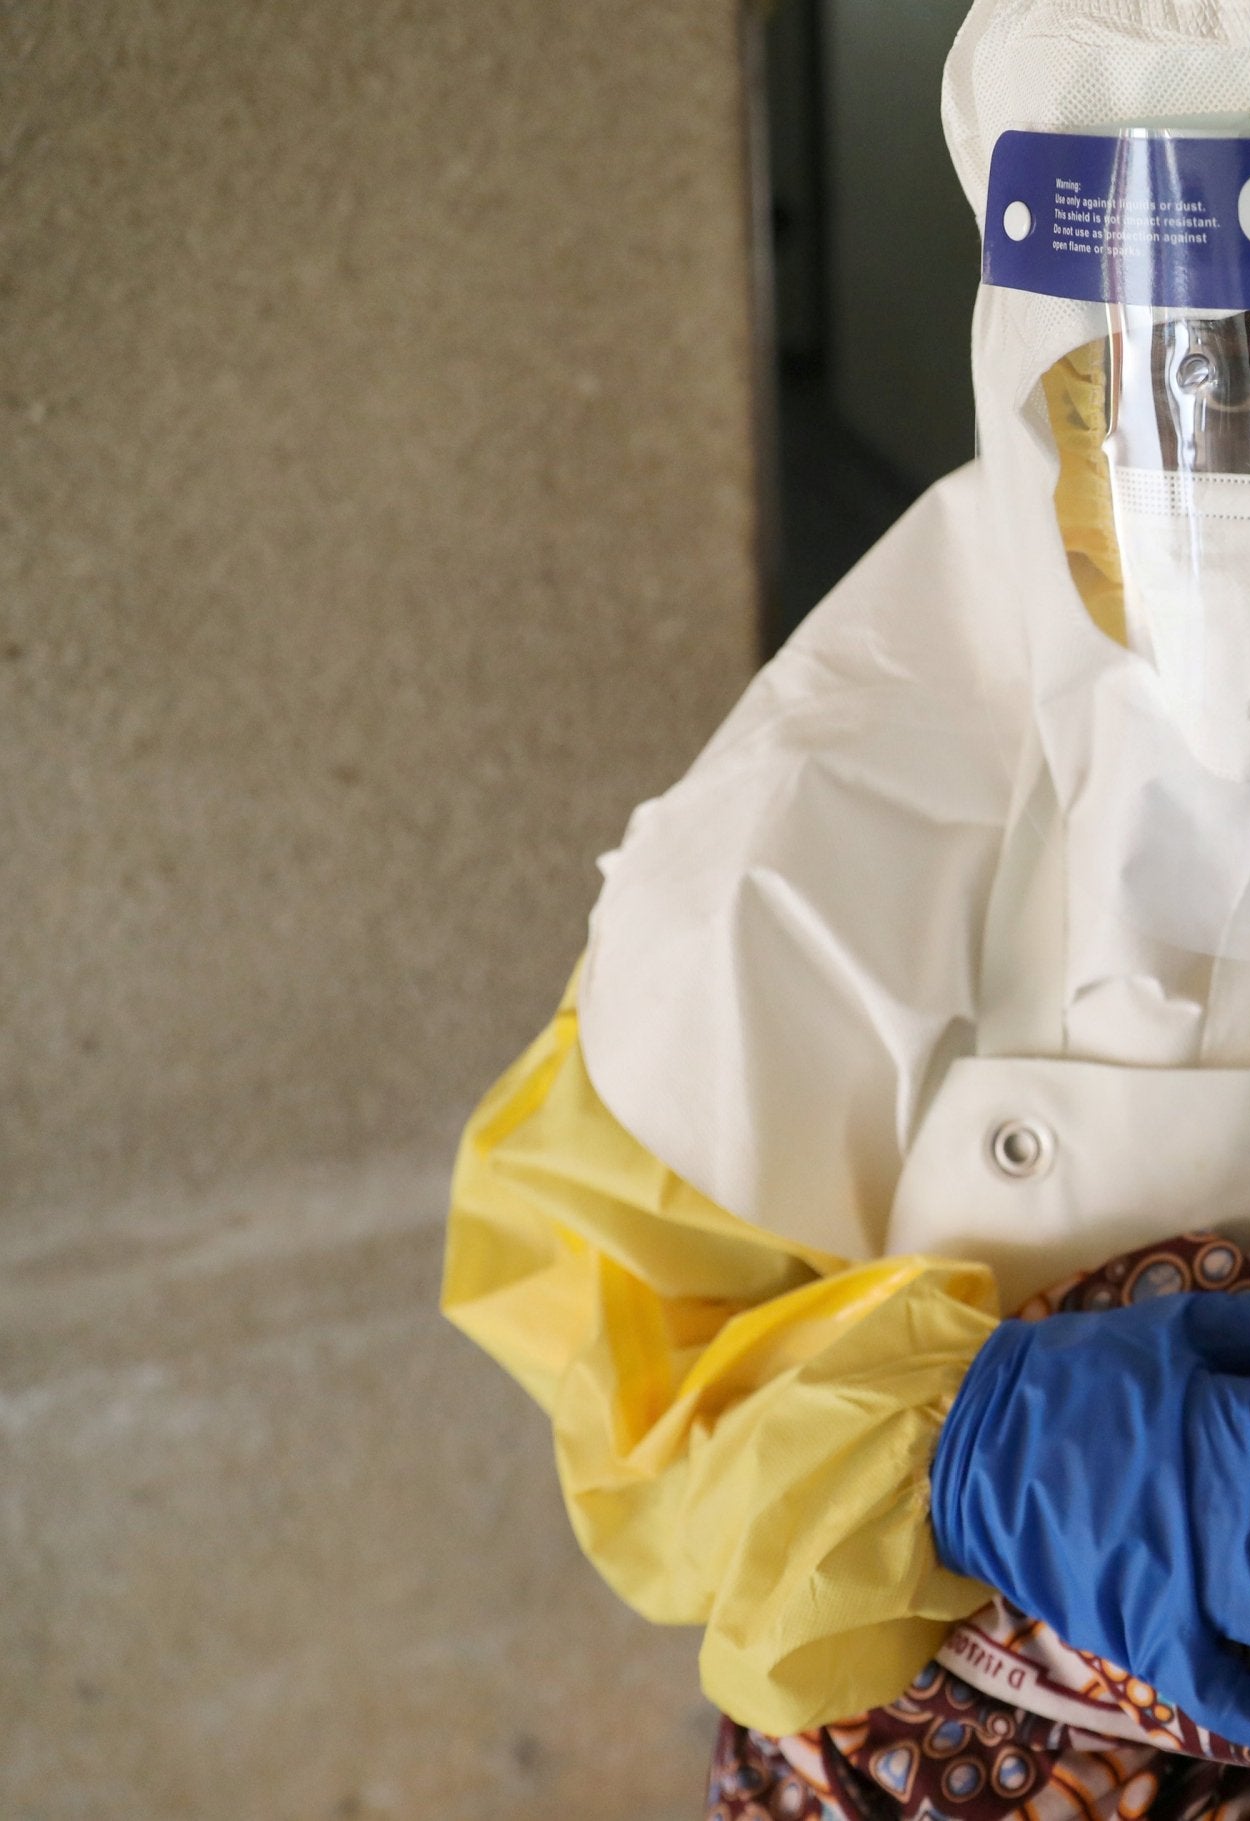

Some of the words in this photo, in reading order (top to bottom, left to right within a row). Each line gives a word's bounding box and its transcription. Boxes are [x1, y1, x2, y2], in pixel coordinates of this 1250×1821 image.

[1055, 178, 1081, 192] Warning:
[1055, 194, 1066, 205] Use
[1066, 195, 1081, 208] only
[1082, 197, 1116, 211] against
[1159, 202, 1172, 211] or
[1176, 200, 1206, 212] dust.
[1054, 209, 1067, 220] This
[1067, 210, 1090, 223] shield
[1092, 212, 1101, 223] is
[1104, 214, 1121, 225] not
[1163, 216, 1221, 228] resistant.
[1053, 223, 1062, 234] Do
[1062, 225, 1074, 236] not
[1074, 228, 1089, 237] use
[1092, 229, 1103, 238] as
[1105, 229, 1160, 243] protection
[1163, 231, 1208, 245] against
[1052, 240, 1068, 251] open
[1068, 240, 1091, 253] flame
[1094, 244, 1104, 254] or
